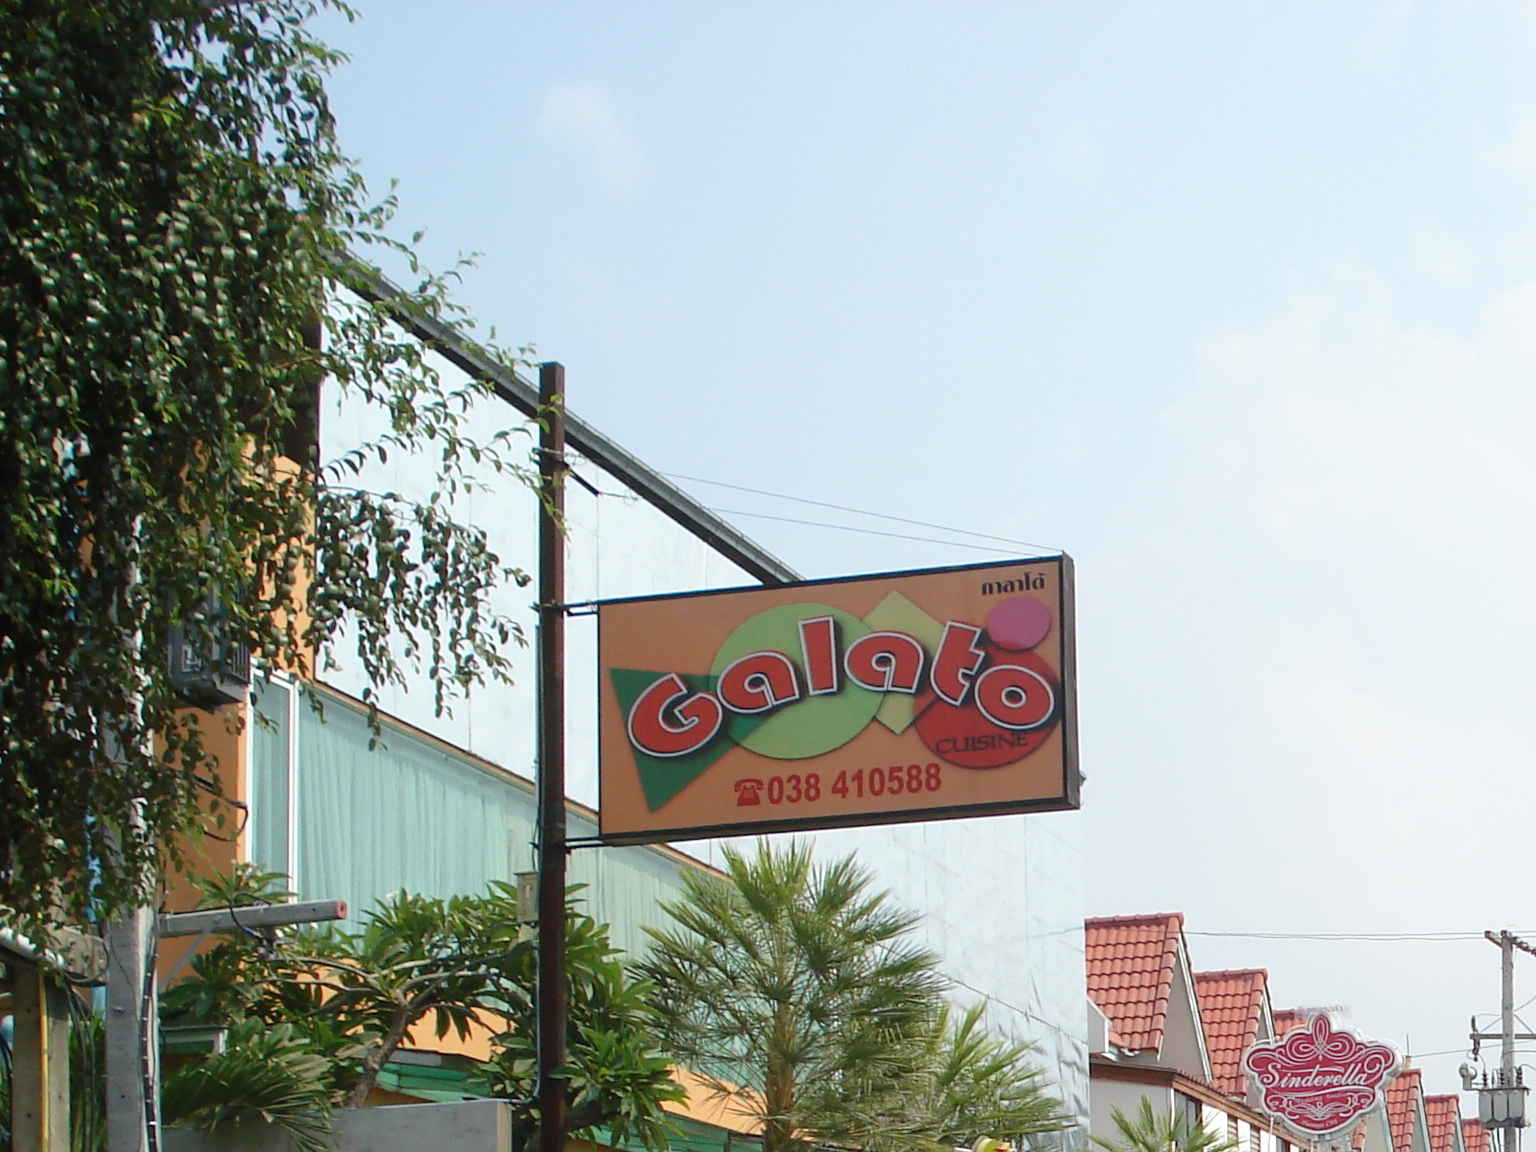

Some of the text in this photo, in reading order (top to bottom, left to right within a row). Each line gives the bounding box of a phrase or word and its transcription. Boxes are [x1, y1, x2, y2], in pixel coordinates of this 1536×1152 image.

[981, 572, 1046, 596] กาลาโต้
[627, 614, 1056, 759] Galato
[935, 731, 1029, 755] CUISINE
[767, 762, 942, 803] 038 410588
[1261, 1061, 1376, 1089] Sinderella
